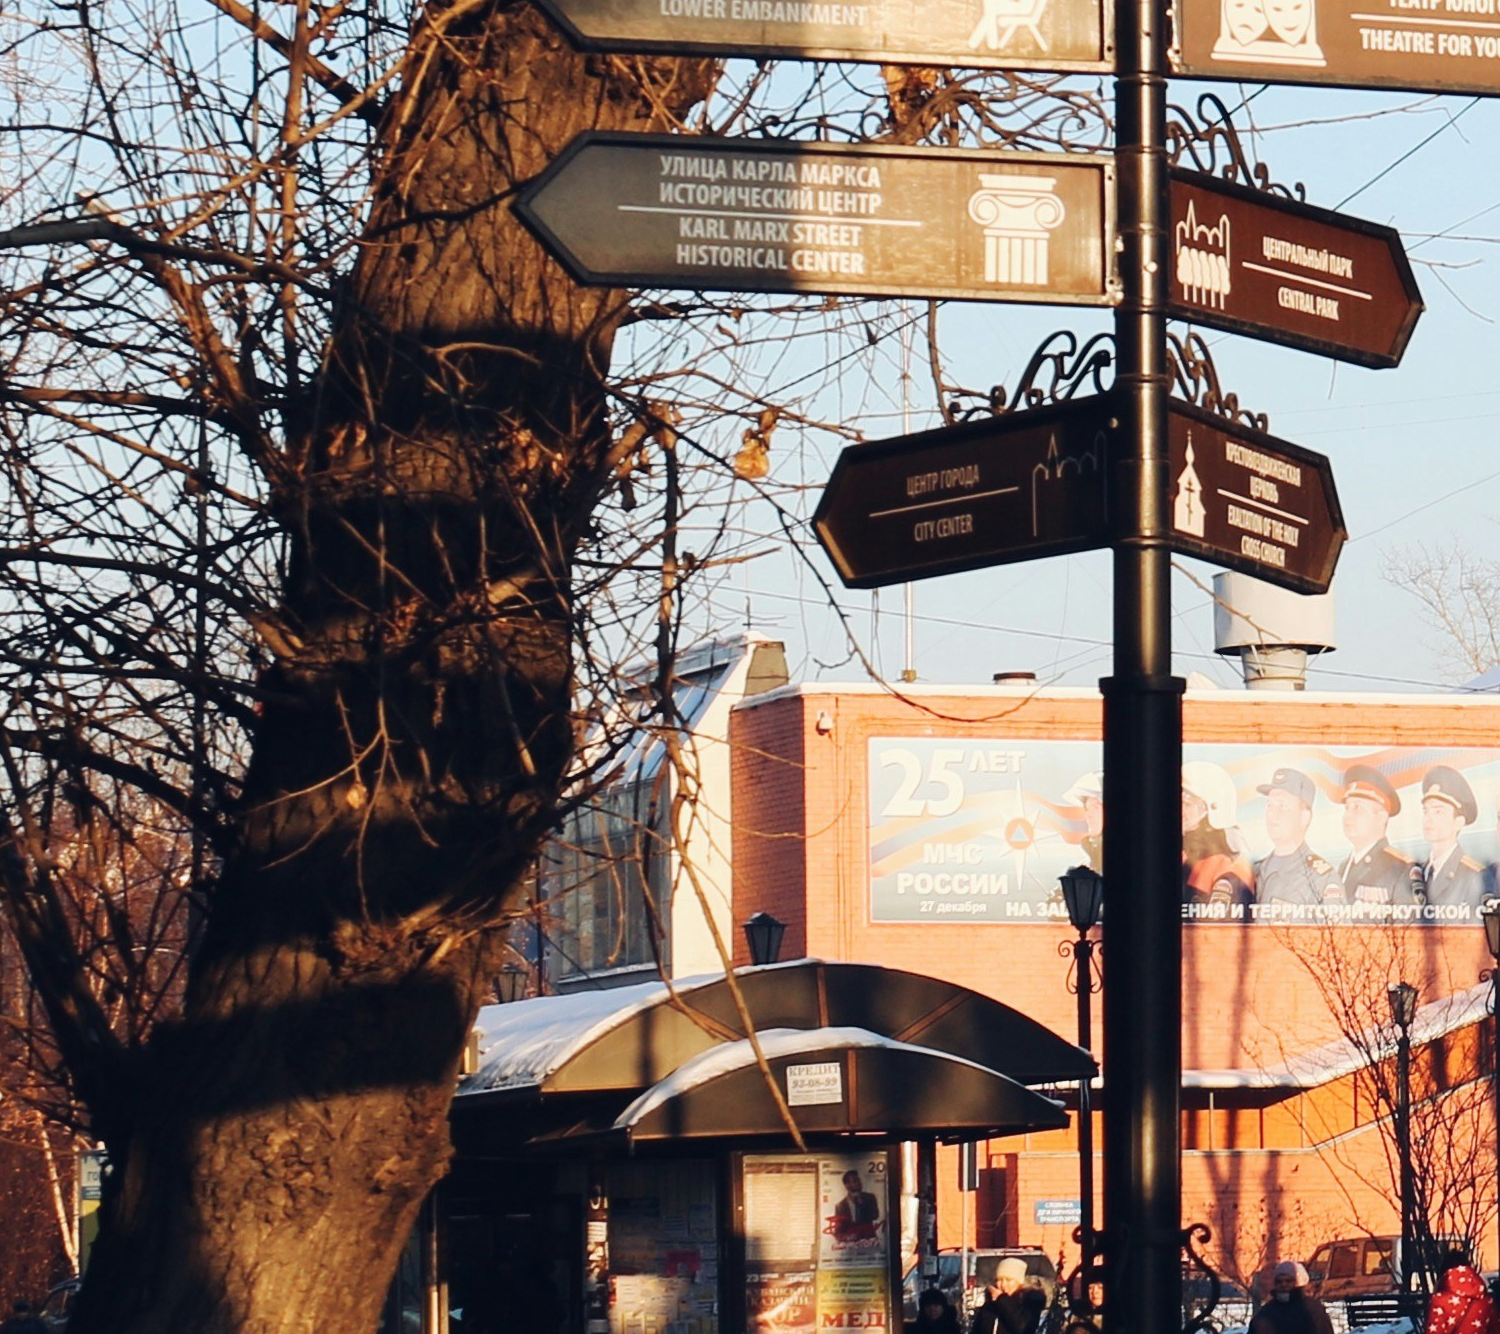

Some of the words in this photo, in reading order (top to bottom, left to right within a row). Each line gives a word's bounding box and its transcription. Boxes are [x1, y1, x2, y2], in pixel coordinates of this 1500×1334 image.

[730, 0, 867, 27] EMBANKMENT
[1359, 27, 1435, 56] THEATRE
[1438, 32, 1473, 57] FOR
[659, 154, 728, 182] УЛИЦА
[731, 159, 798, 183] КАРЛА
[800, 162, 881, 188] МАРКСА
[659, 182, 814, 212] ИСТОРИЧЕСКИЙ
[818, 190, 882, 215] ЦЕНТР
[679, 217, 730, 241] KARL
[733, 219, 789, 243] MARX
[791, 223, 863, 247] STREET
[676, 243, 789, 270] HISTORICAL
[791, 249, 865, 274] CENTER
[1263, 235, 1329, 274] ЦЕНТРАЛЬНЫЙ
[1329, 253, 1354, 280] ПАРК
[1278, 286, 1317, 316] CENTRAL
[1315, 295, 1340, 322] PARK
[907, 471, 939, 499] ЦЕНТР
[941, 464, 980, 489] ГОРОДА
[914, 520, 936, 543] CITY
[936, 513, 974, 538] CENTER
[1271, 519, 1284, 543] THE
[1241, 534, 1262, 558] CROSS
[1261, 540, 1286, 568] CHURCH
[879, 747, 967, 818] 25
[966, 749, 1027, 774] ЛЕТ
[922, 842, 984, 867] МЧС
[896, 872, 1009, 896] РОССИИ
[919, 900, 936, 913] 27
[937, 899, 988, 915] декабря
[1005, 900, 1034, 918] НА
[1229, 903, 1244, 919] И
[1248, 901, 1369, 920] ТЕРРИТОРИЙ
[1368, 900, 1470, 920] ИРКУТСКОЙ
[789, 1064, 838, 1077] КРЕДИТ
[868, 1161, 886, 1173] 20
[820, 1311, 886, 1330] МЕД
